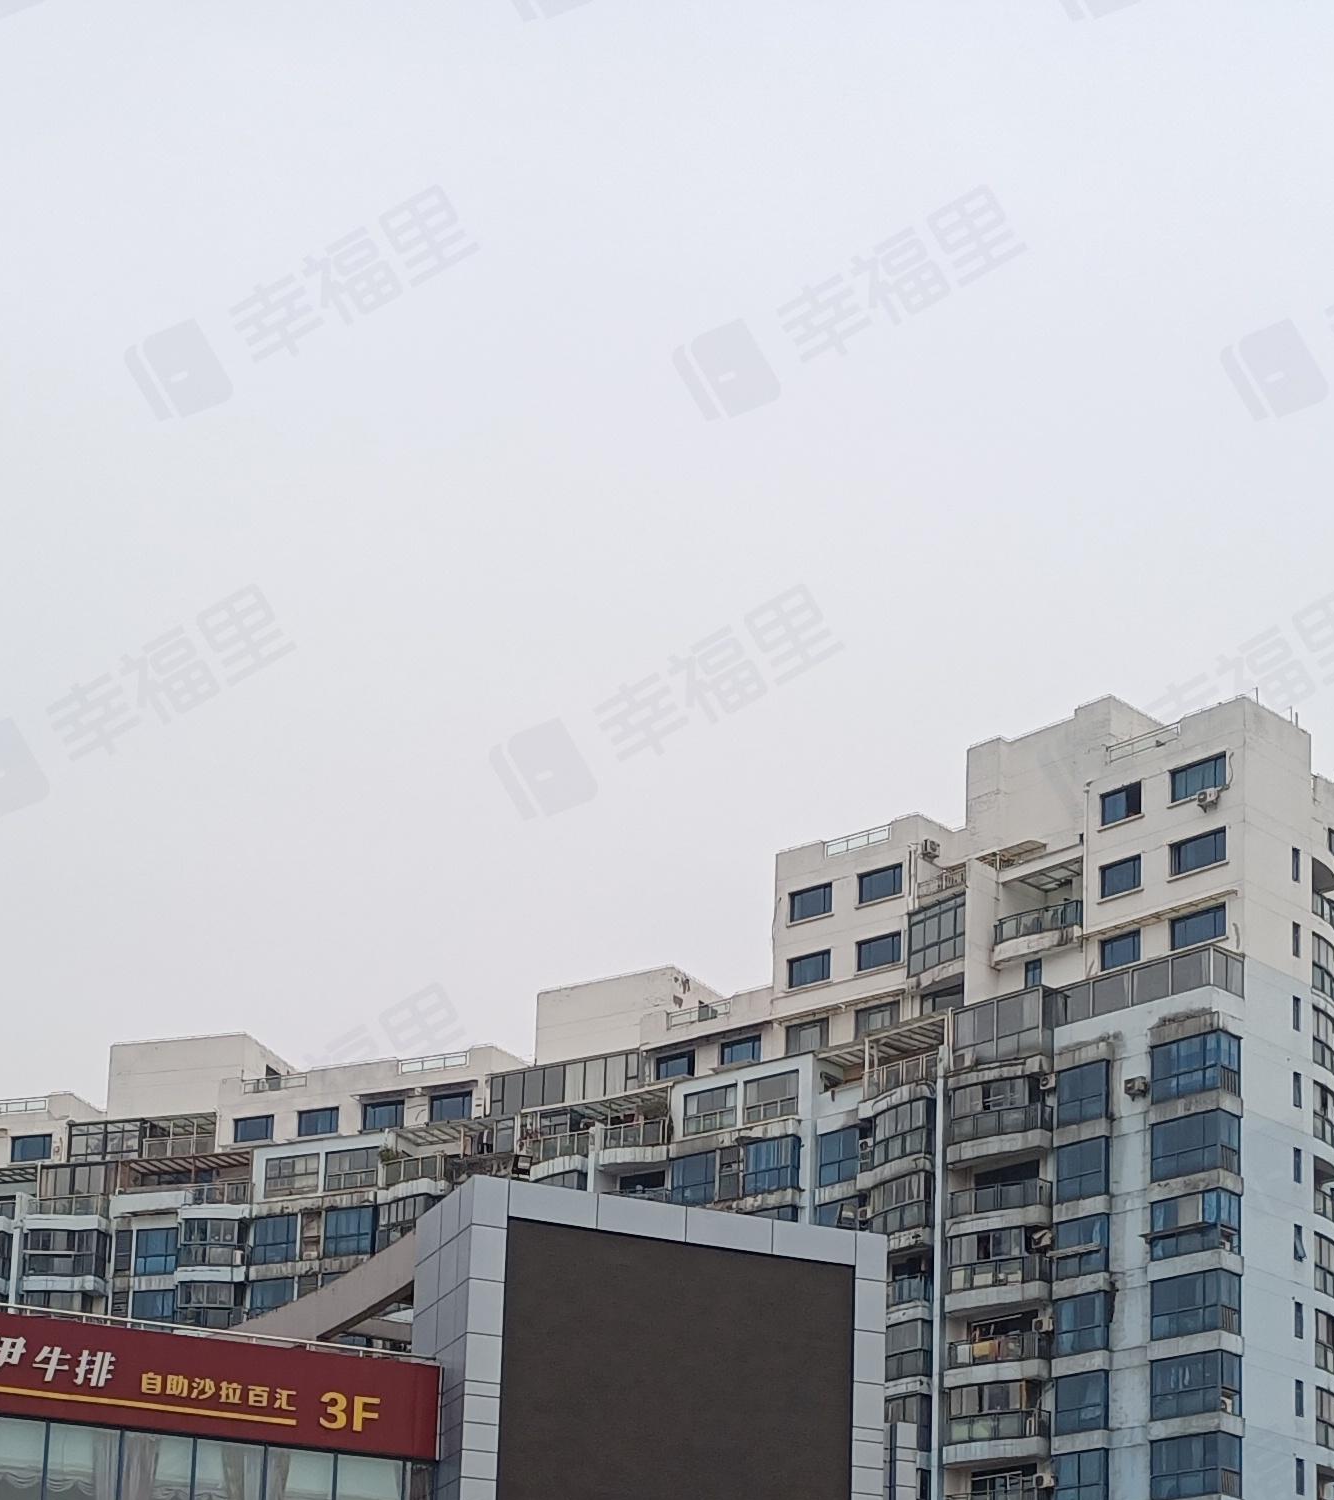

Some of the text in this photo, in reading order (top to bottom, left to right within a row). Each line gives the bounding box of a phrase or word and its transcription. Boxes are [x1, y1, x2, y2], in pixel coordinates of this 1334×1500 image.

[141, 1371, 298, 1412] 自助沙拉百汇
[318, 1390, 382, 1432] 3F
